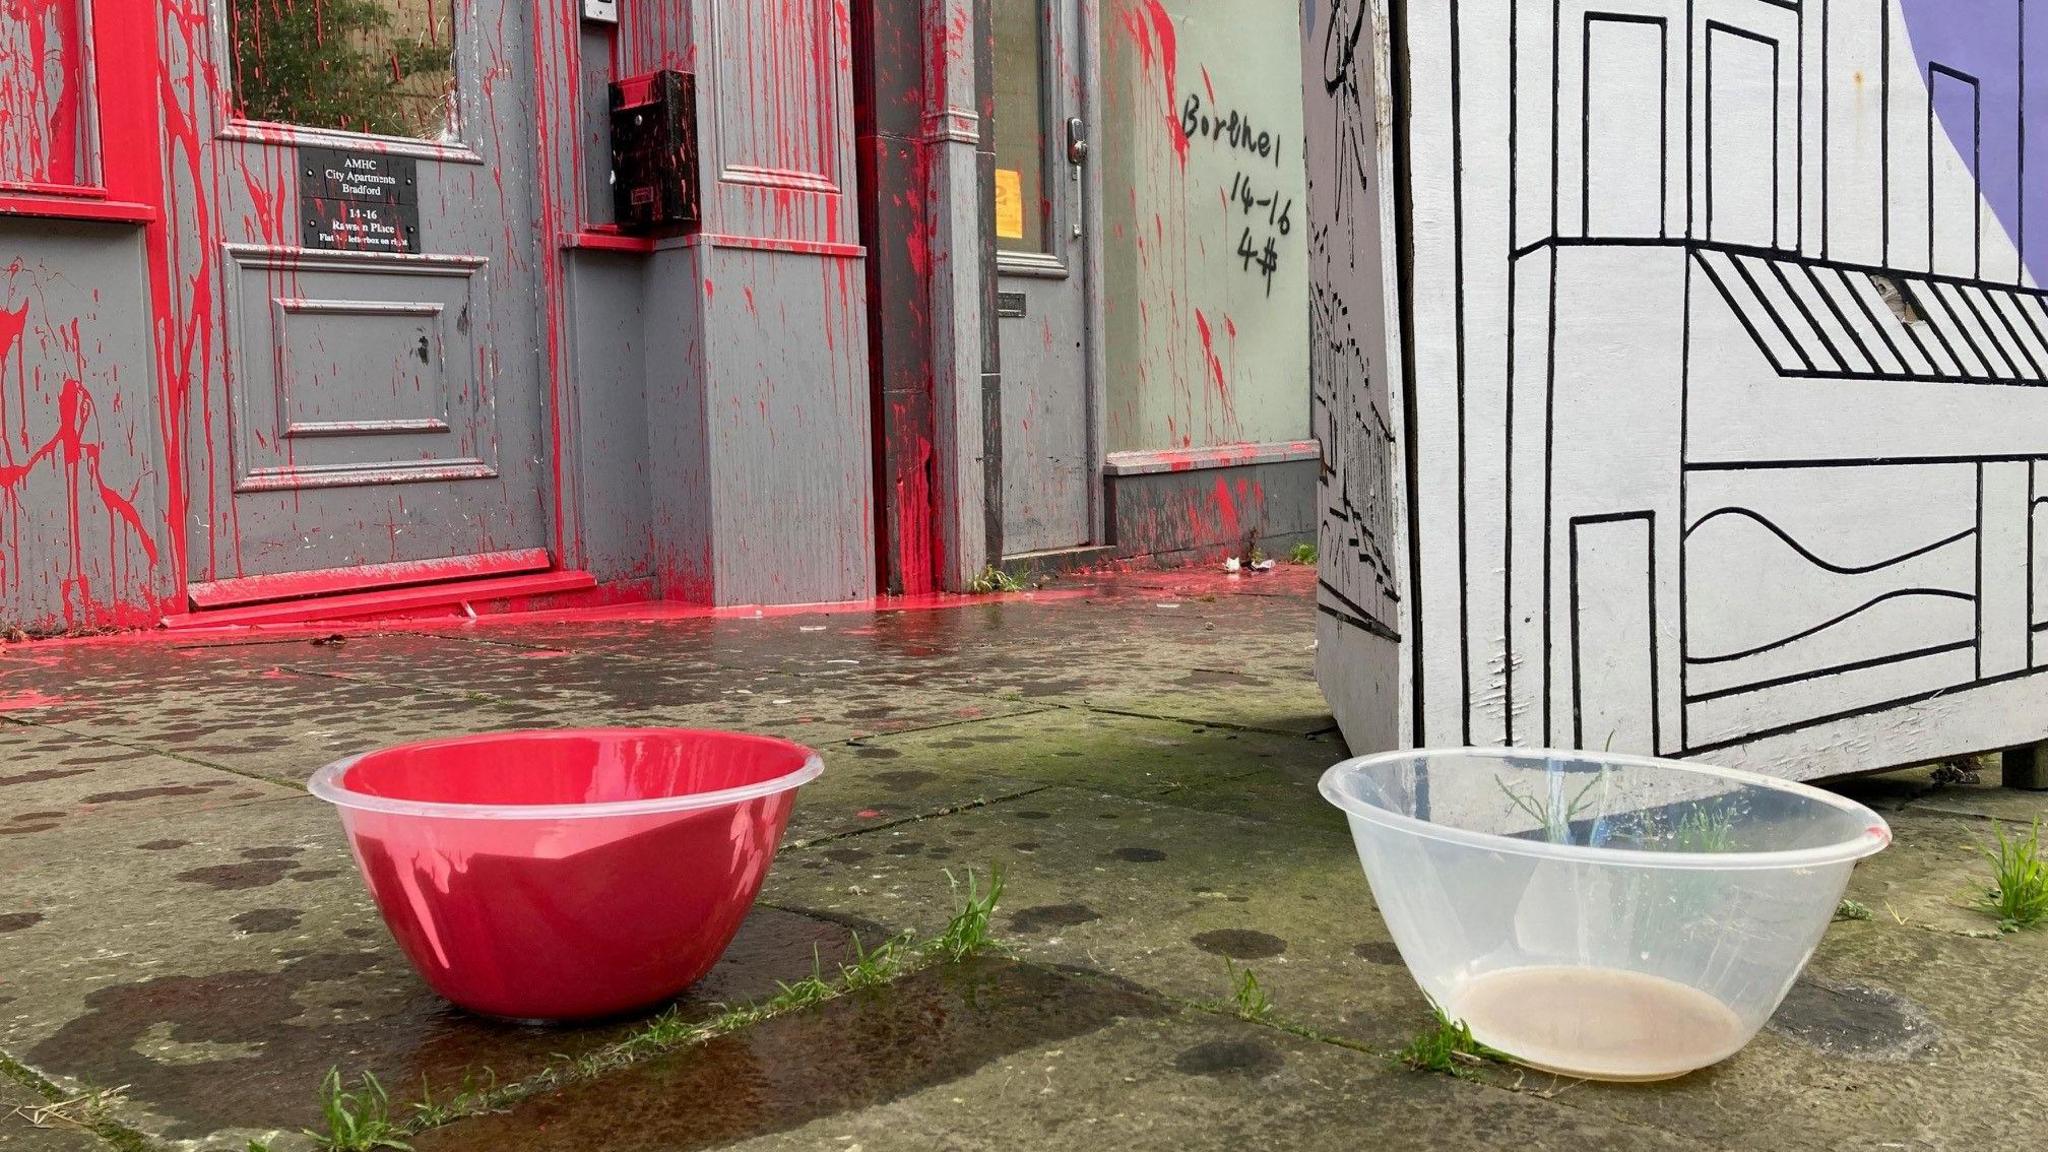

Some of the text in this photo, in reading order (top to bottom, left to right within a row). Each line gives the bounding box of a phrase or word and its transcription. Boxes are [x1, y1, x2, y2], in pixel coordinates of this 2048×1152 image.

[344, 158, 377, 170] AMHC
[325, 168, 396, 184] City Apartments
[342, 183, 381, 196] Bradford
[1231, 171, 1292, 235] 14-16
[332, 220, 369, 231] Rawsn
[348, 235, 379, 244] lettrbox
